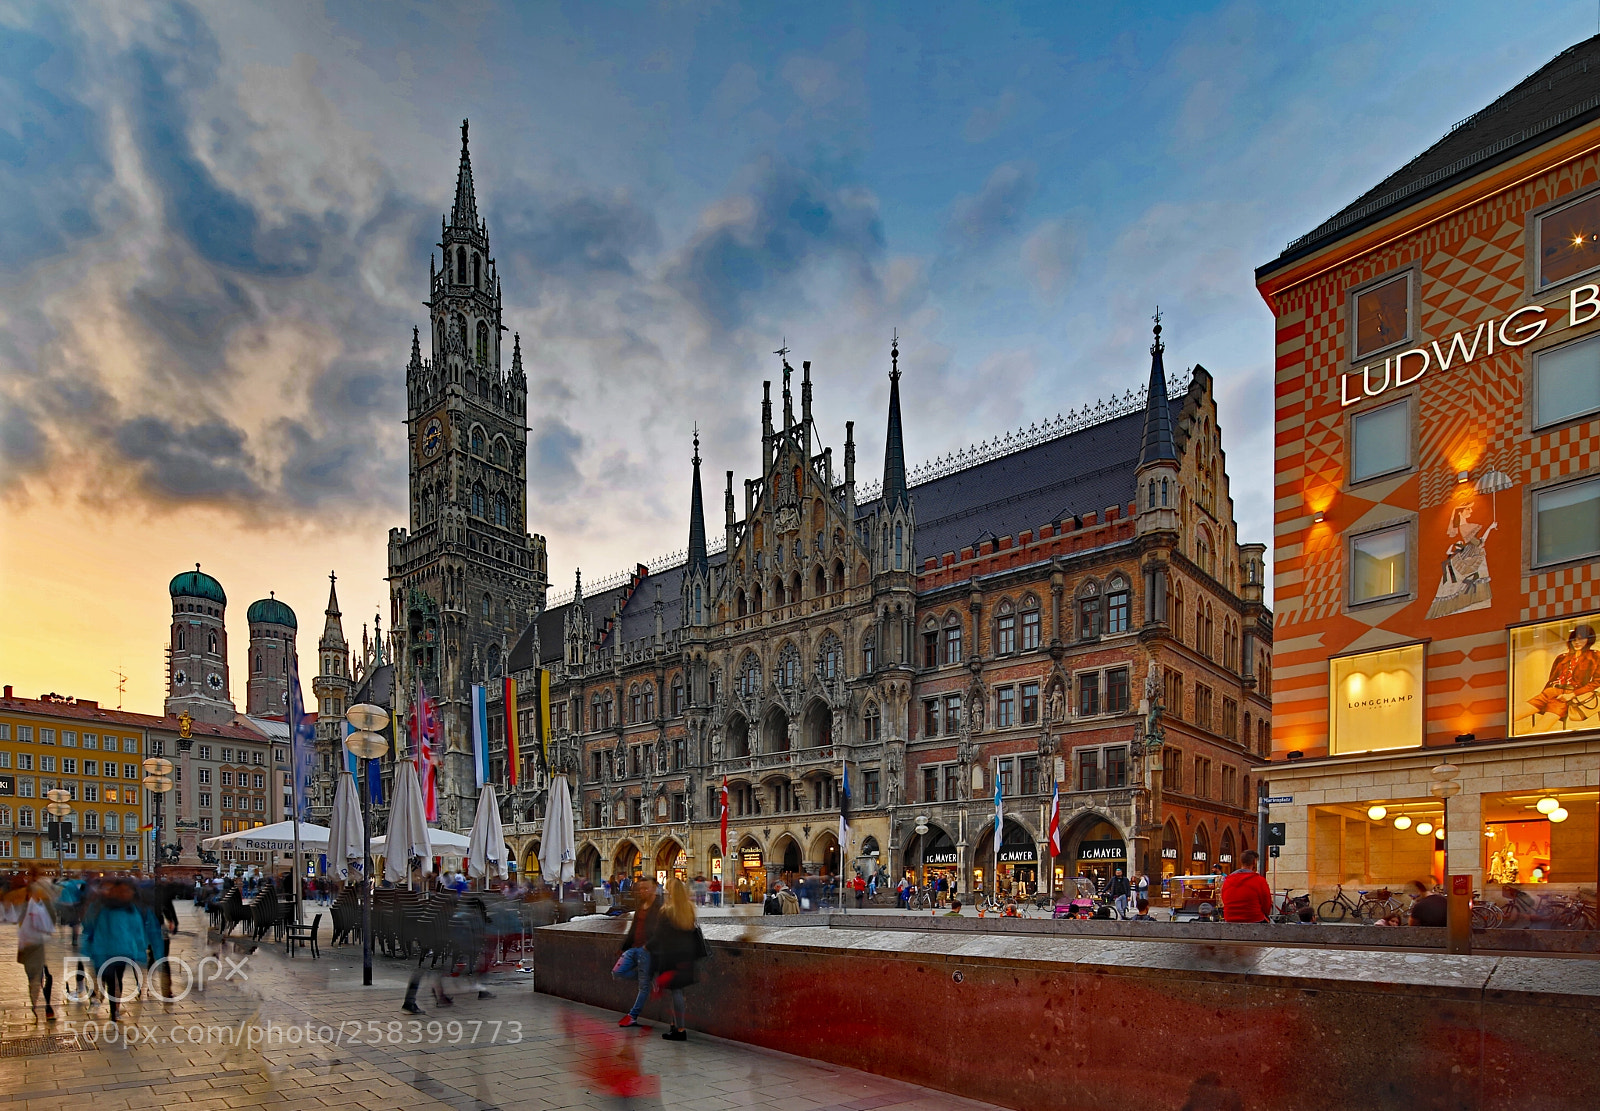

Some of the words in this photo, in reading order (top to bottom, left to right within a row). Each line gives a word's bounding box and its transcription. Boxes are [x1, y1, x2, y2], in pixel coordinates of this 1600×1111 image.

[1341, 305, 1548, 407] LUDWIG
[1348, 694, 1413, 709] LONGCHAMP
[246, 839, 305, 850] Restaurat
[934, 853, 957, 863] MAYER
[1008, 850, 1033, 861] MAYER
[1093, 847, 1122, 858] MAYER
